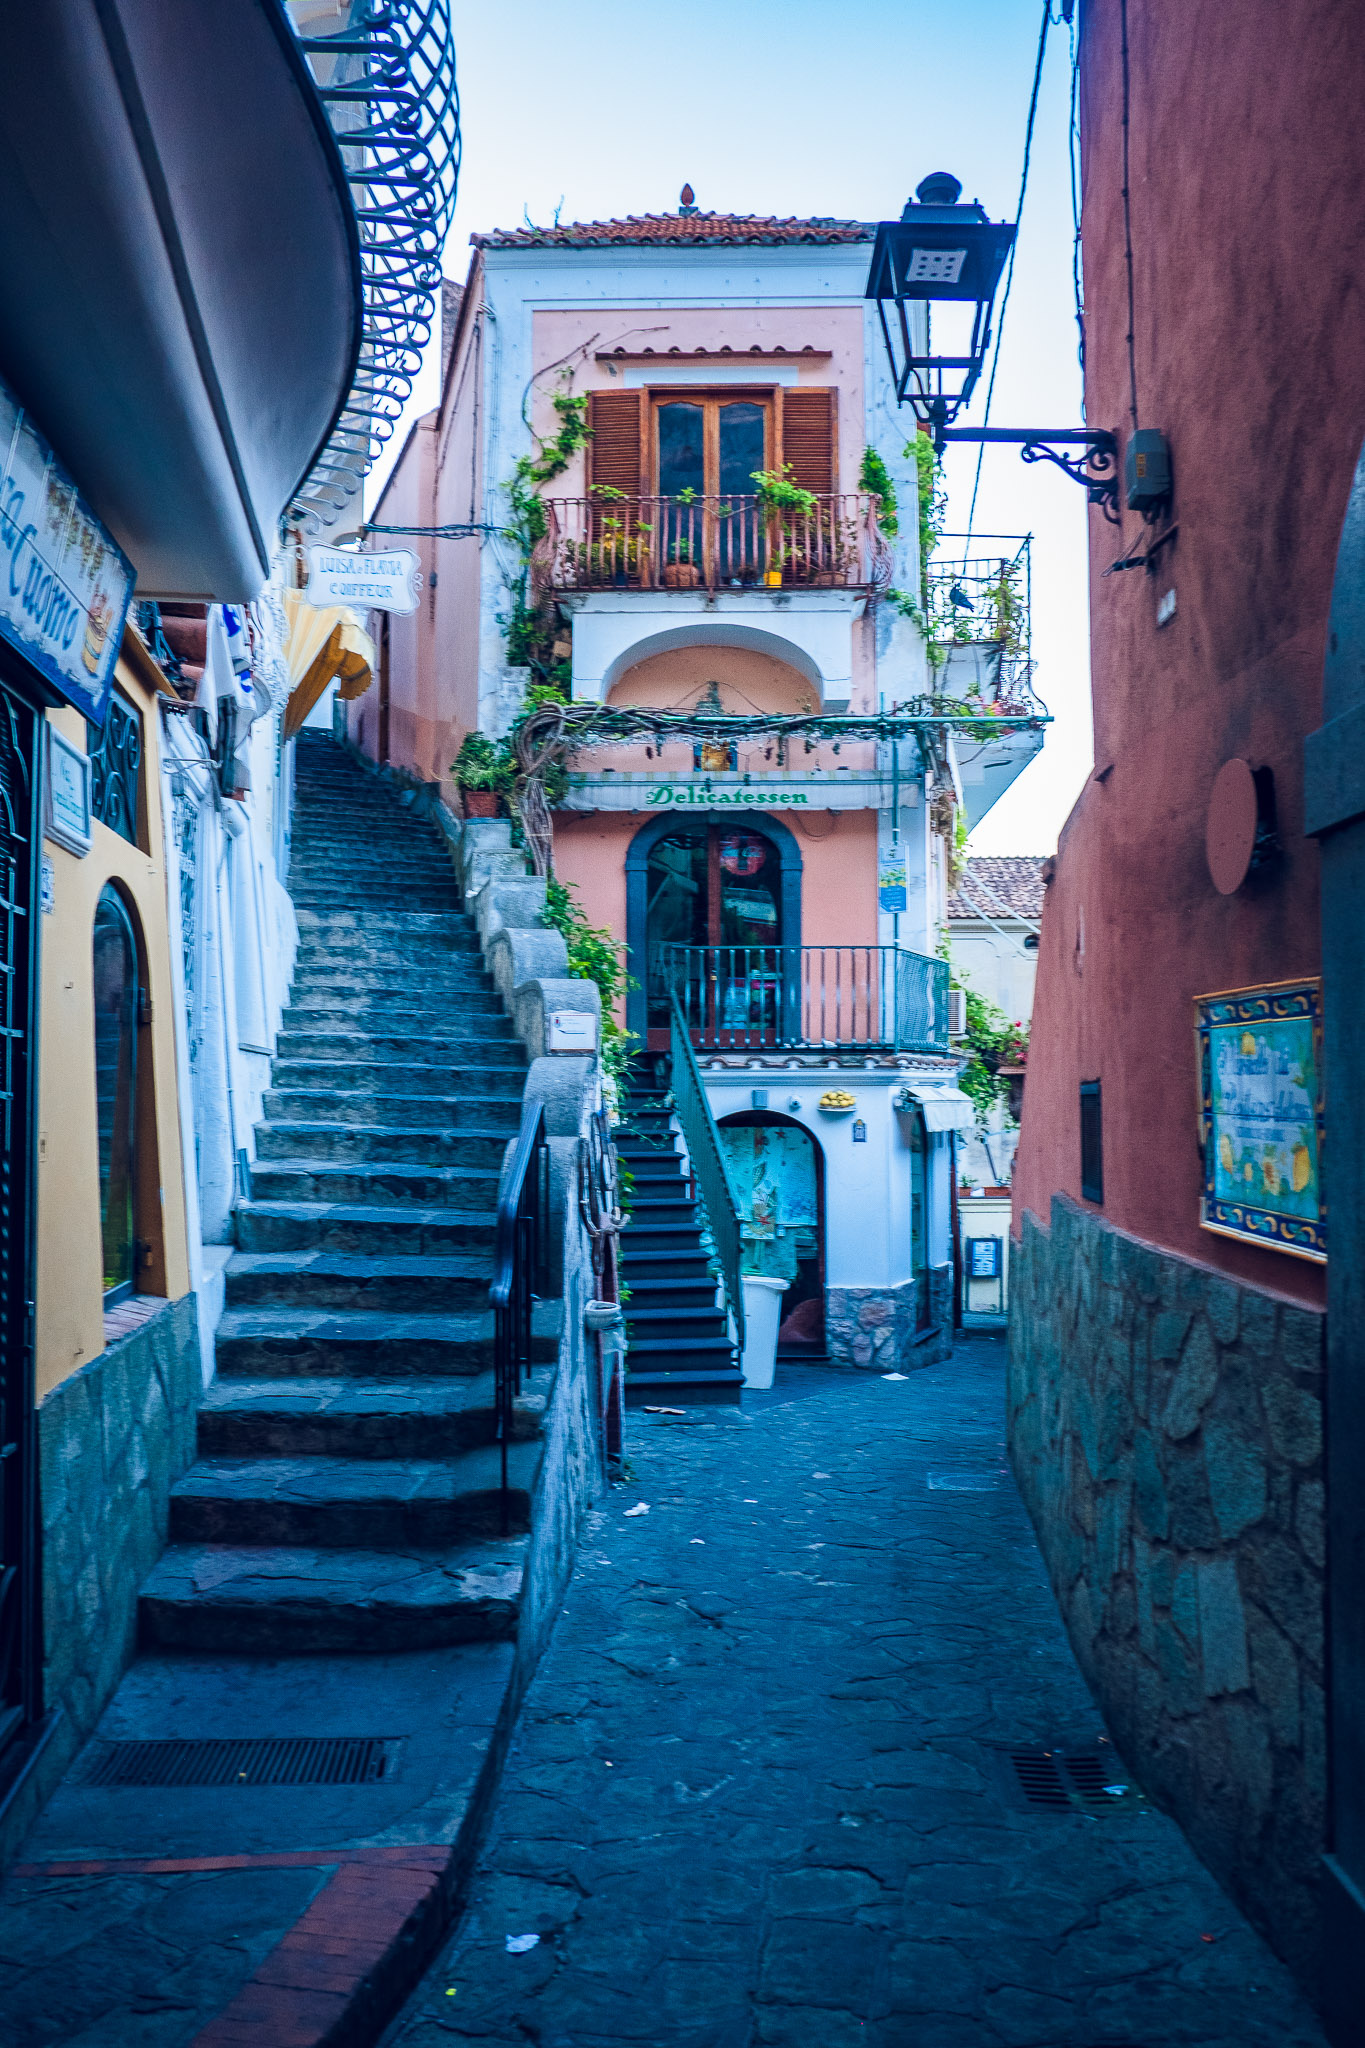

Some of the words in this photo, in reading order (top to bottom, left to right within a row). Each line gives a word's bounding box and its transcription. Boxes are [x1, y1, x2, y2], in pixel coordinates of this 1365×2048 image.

[320, 557, 356, 574] LUISA
[330, 582, 393, 598] COIFFEUR
[646, 785, 808, 804] Delicatessen
